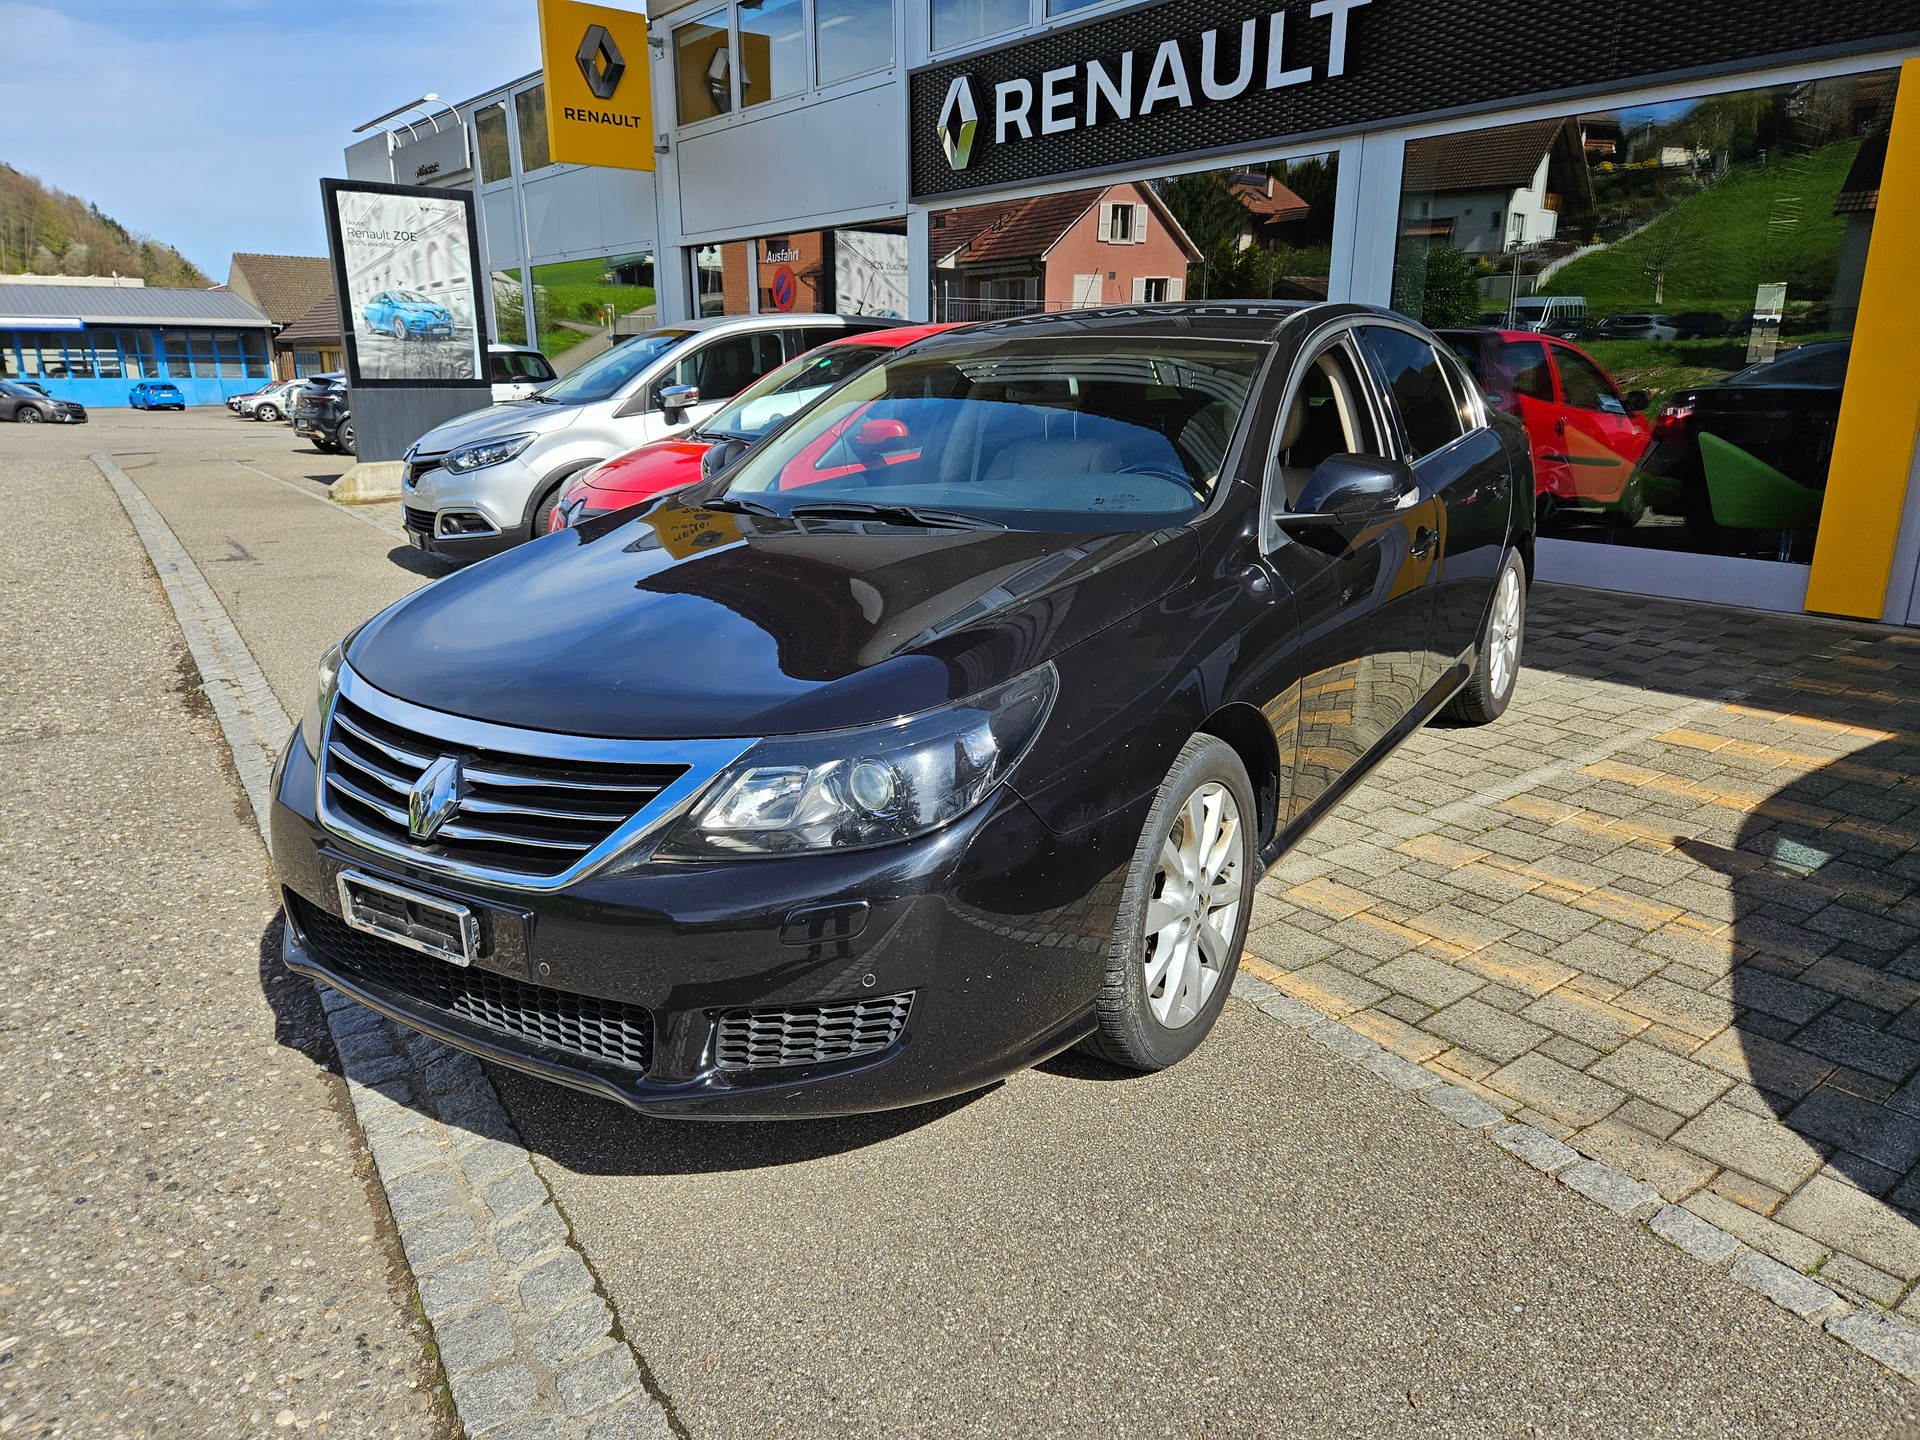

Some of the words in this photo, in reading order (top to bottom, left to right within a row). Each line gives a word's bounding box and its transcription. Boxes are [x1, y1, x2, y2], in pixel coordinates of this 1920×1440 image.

[995, 0, 1373, 144] RENAULT
[564, 106, 641, 128] RENAULT
[346, 227, 391, 240] Renault
[393, 230, 418, 242] ZOE
[766, 248, 799, 263] Ausfahrt
